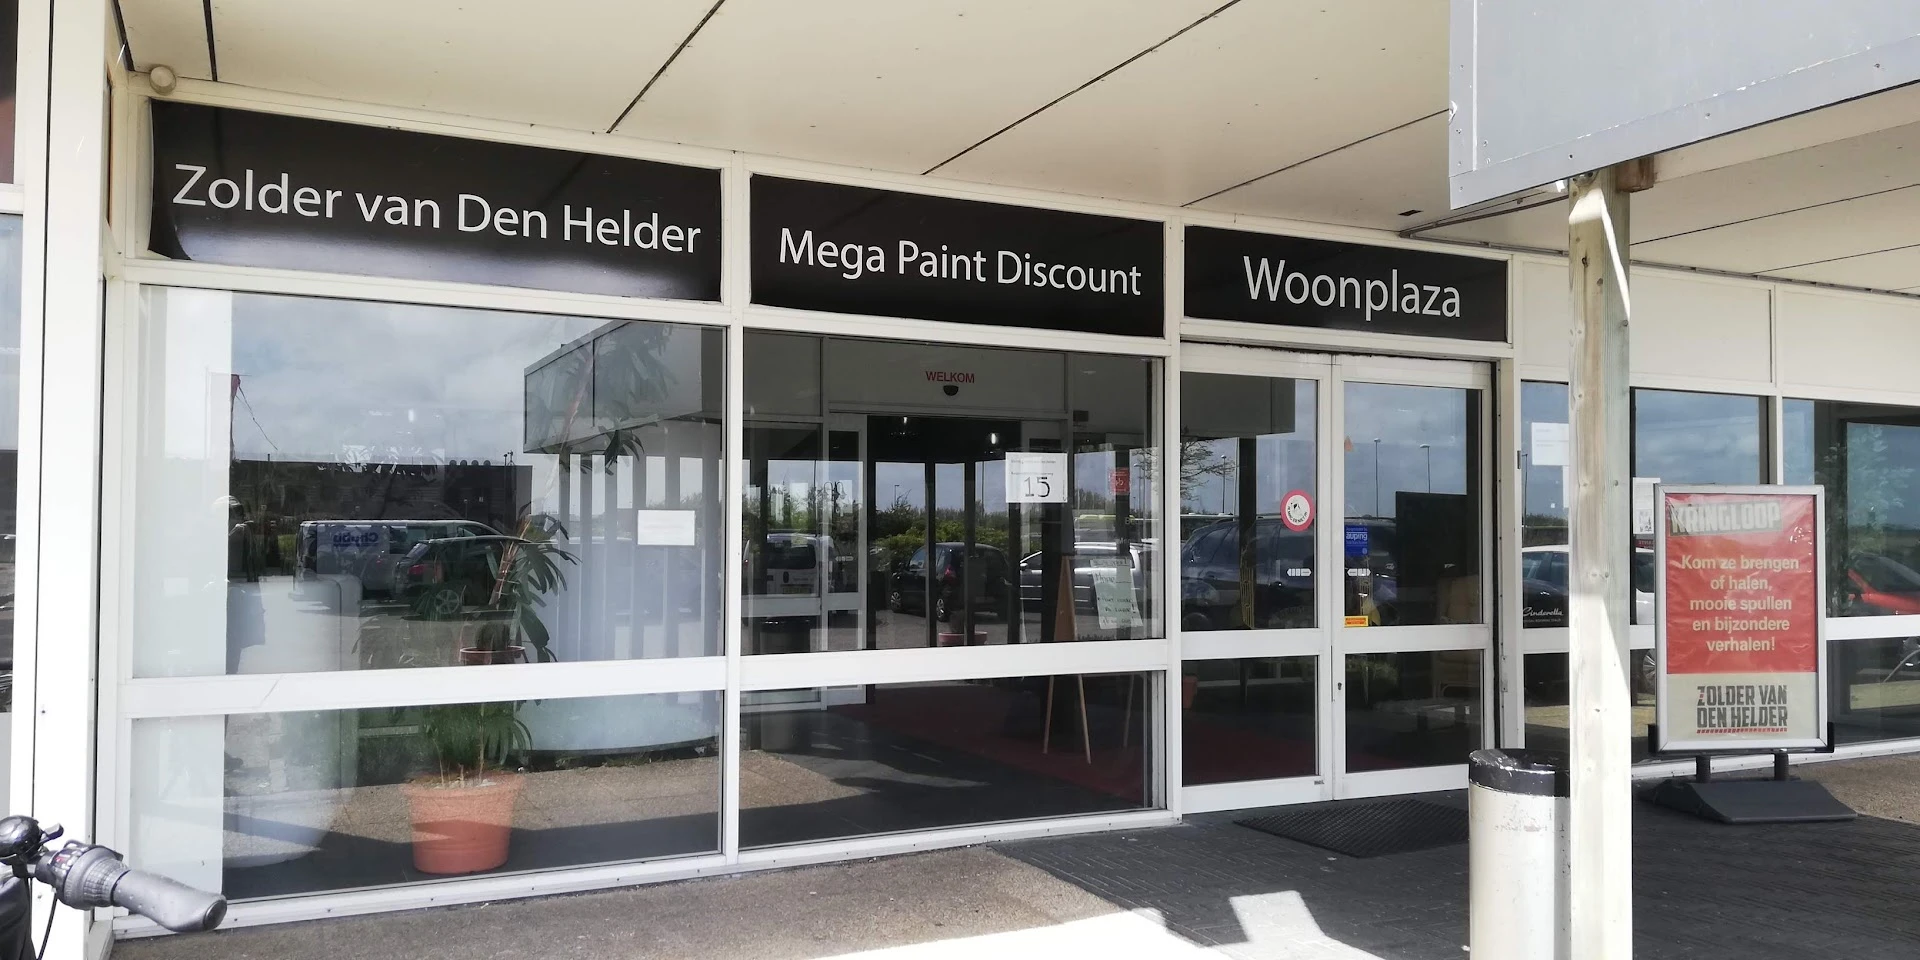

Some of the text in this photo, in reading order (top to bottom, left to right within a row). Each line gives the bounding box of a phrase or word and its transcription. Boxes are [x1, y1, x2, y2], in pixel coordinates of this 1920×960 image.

[172, 163, 702, 253] Zolder van Den Helder
[779, 227, 1142, 296] Mega Paint Discount
[1243, 255, 1461, 322] Woonplaza
[925, 370, 975, 384] WELKOM
[1024, 476, 1051, 498] 15
[1669, 501, 1781, 534] KRINGLOOP
[1681, 555, 1799, 573] Kom ze brengen
[1710, 575, 1773, 593] of halen,
[1523, 606, 1564, 617] Cinderella
[1689, 595, 1792, 614] mooie spullen
[1692, 616, 1790, 634] en bijzondere
[1706, 636, 1776, 652] verhalen!
[1697, 684, 1788, 706] ZOLDER VAN
[1697, 705, 1788, 728] DEN HELDER
